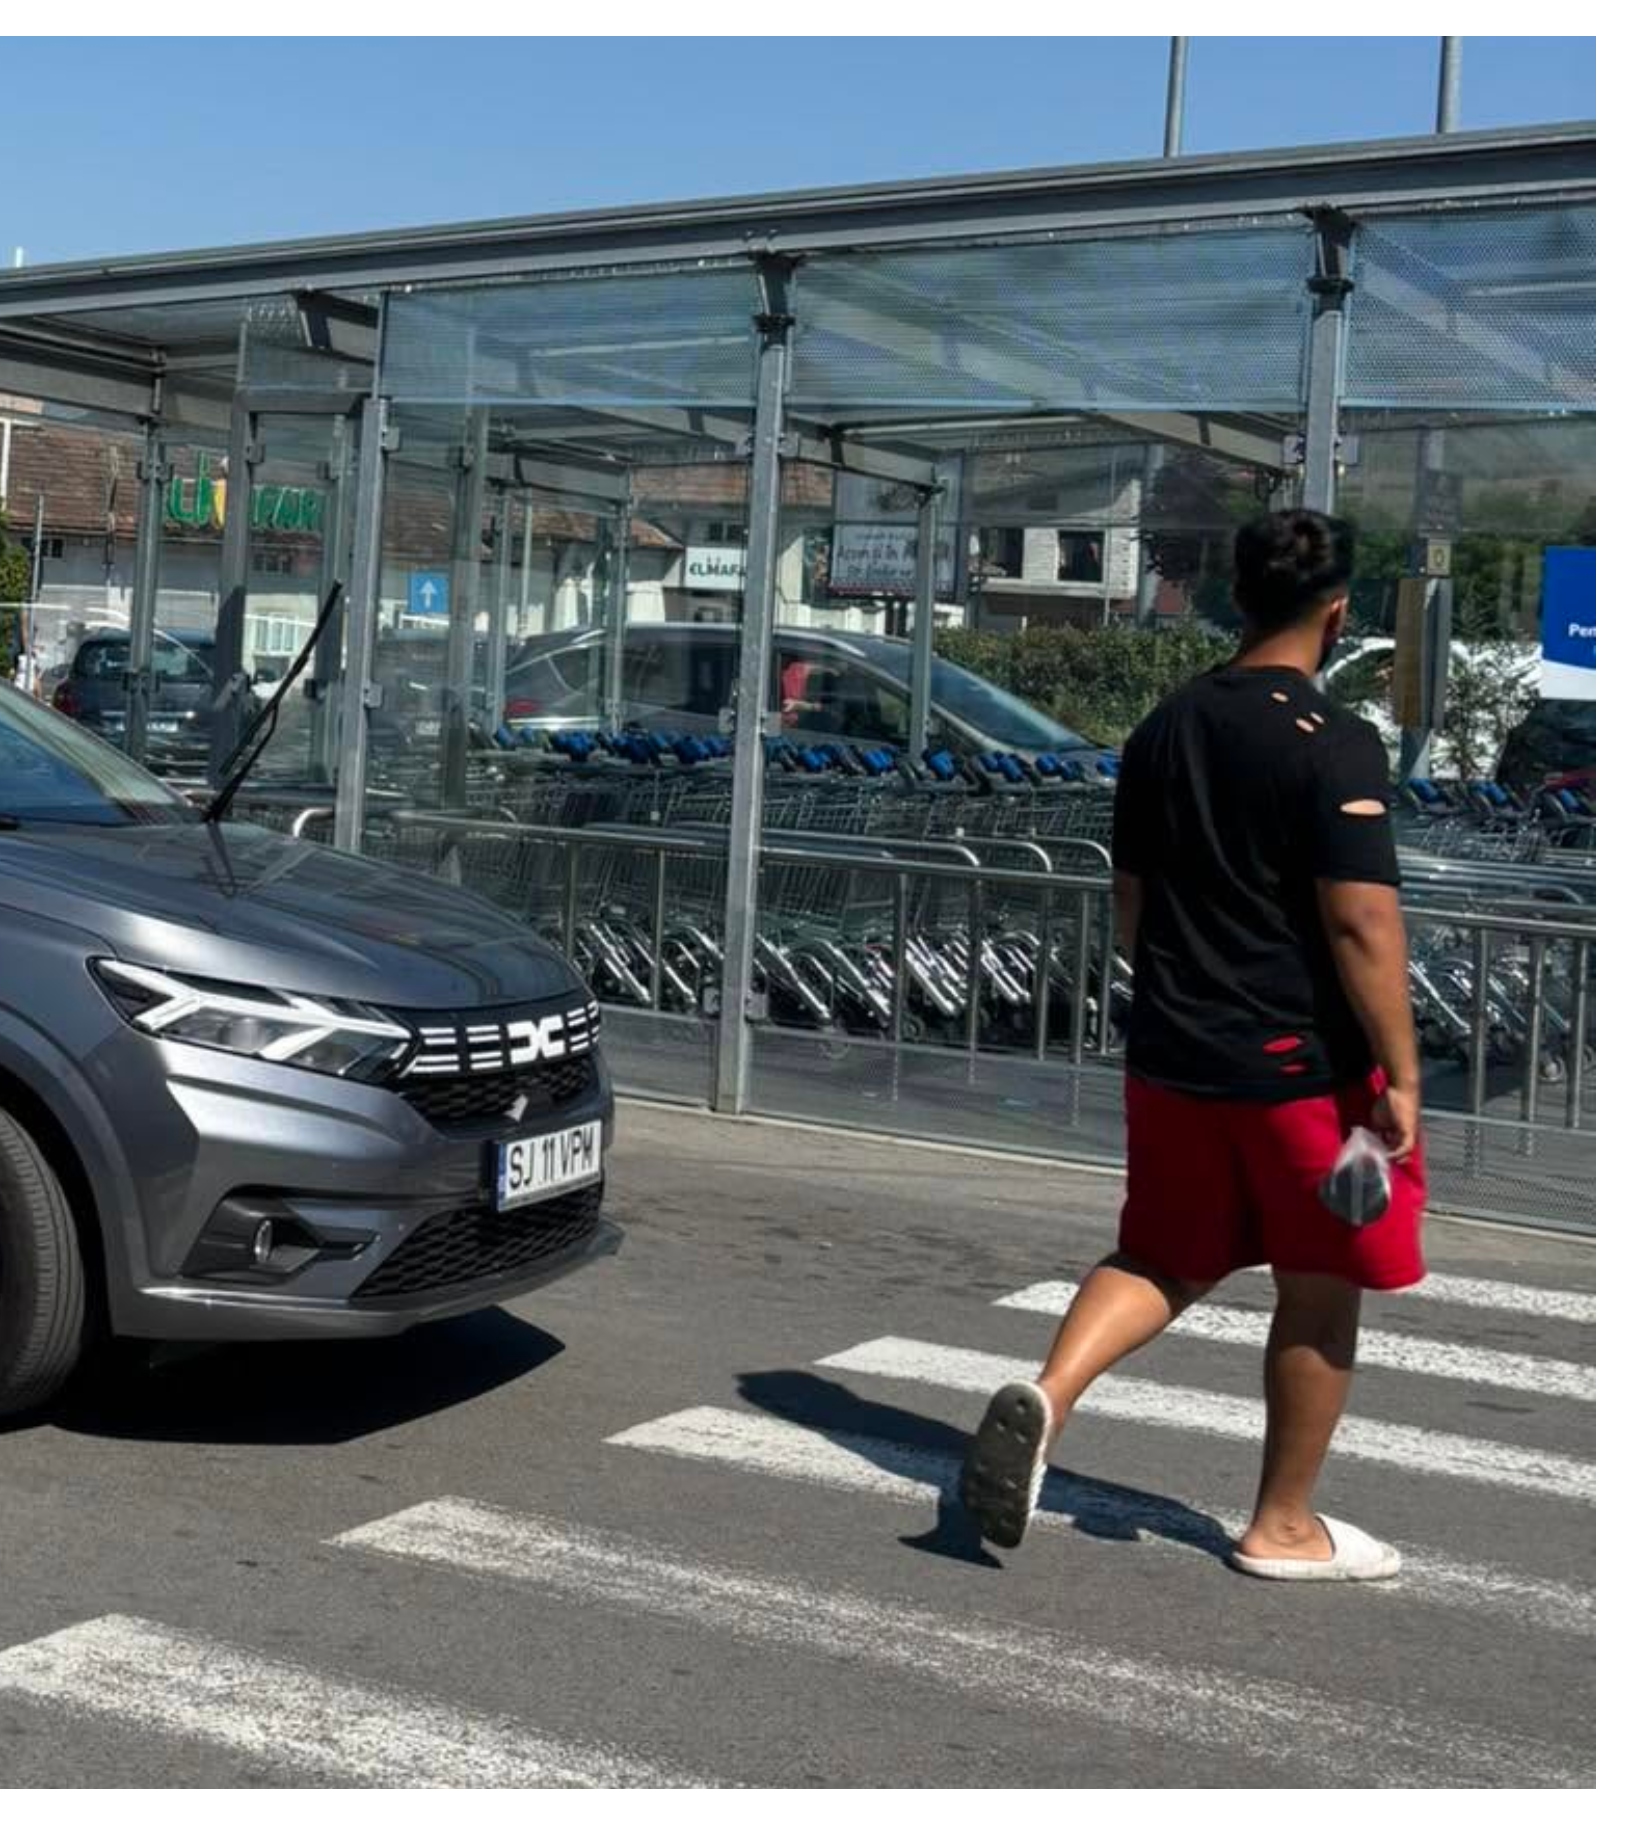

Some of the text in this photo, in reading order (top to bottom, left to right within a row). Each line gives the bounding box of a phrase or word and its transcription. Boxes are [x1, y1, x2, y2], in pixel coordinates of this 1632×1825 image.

[509, 1126, 595, 1190] SJ 11 VPM
